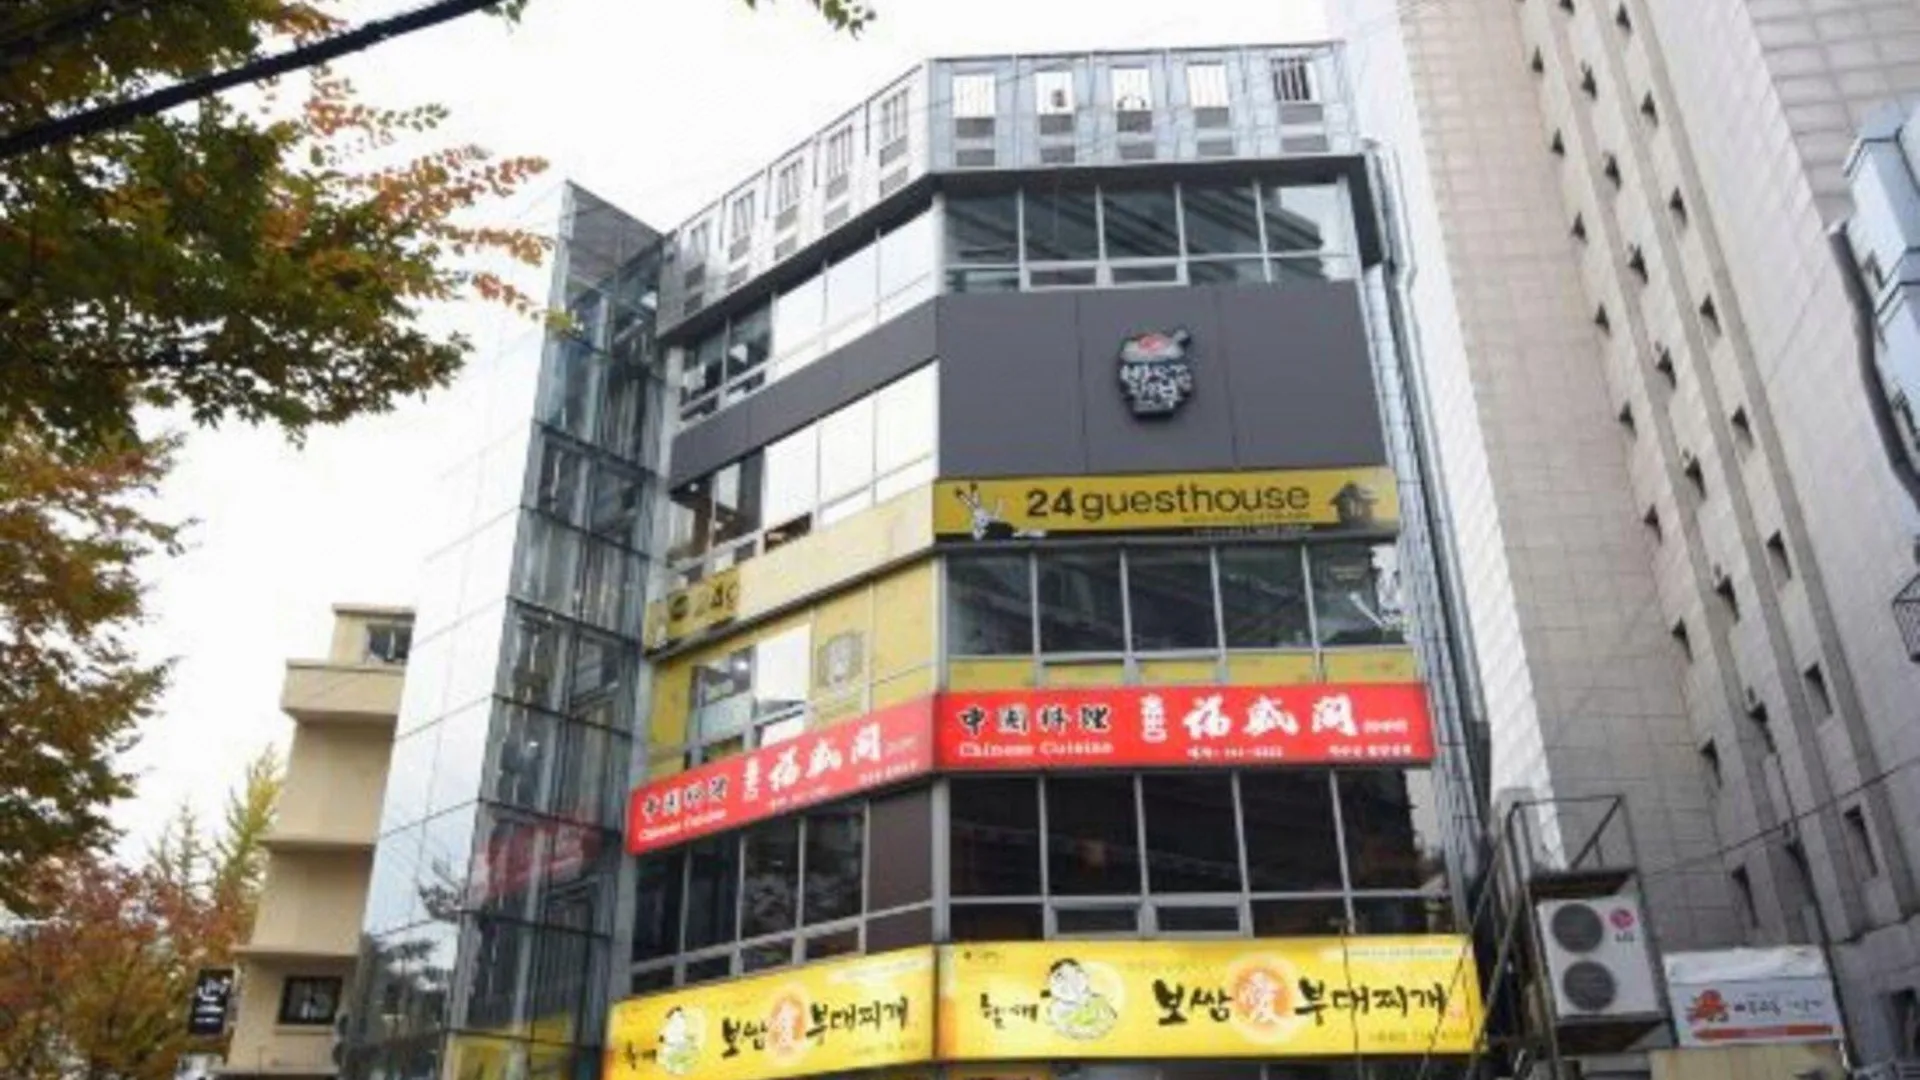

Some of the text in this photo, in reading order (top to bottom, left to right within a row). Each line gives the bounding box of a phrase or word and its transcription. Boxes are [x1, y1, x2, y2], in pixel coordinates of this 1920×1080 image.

[959, 739, 1114, 757] Chinese Cuisine
[1295, 974, 1448, 1026] 부대찌개
